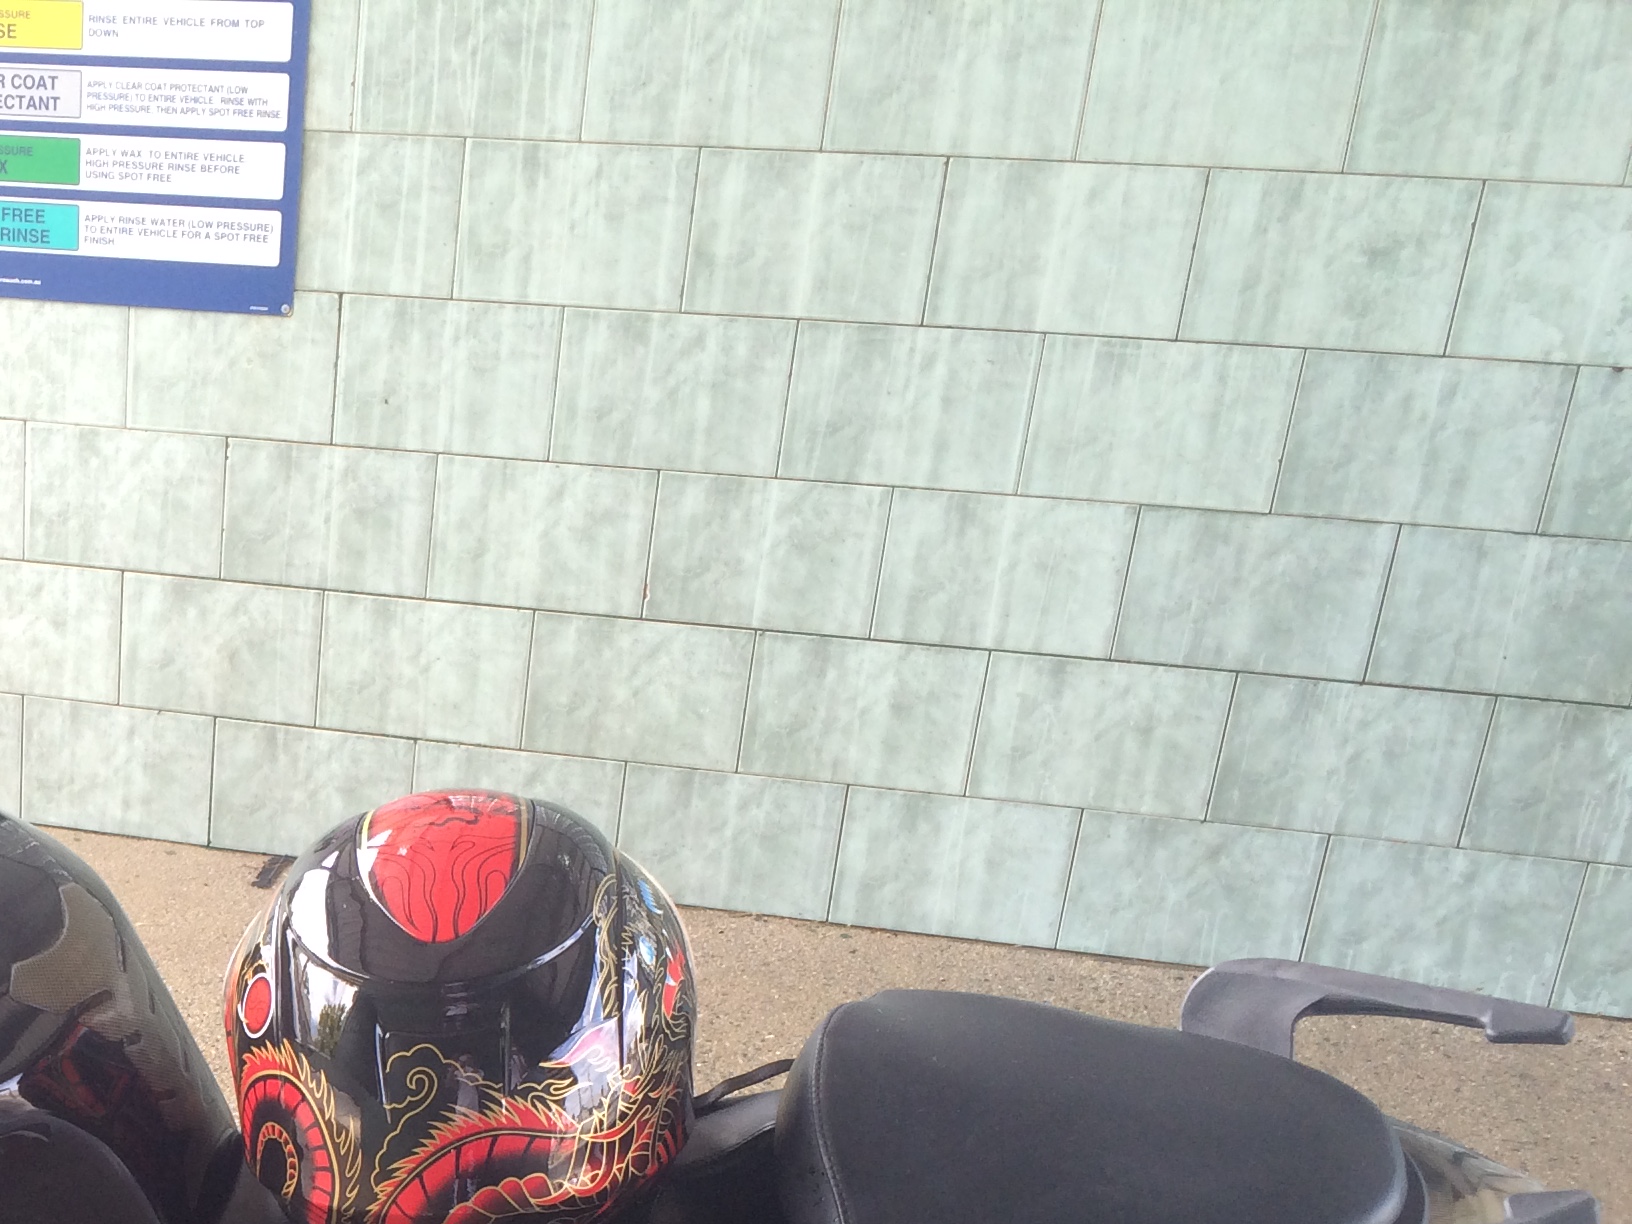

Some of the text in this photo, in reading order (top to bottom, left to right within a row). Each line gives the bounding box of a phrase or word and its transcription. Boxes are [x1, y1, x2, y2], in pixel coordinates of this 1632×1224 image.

[88, 14, 265, 29] RINSE ENTIRE VEHICLE FROM TOP
[88, 28, 119, 38] DOWN
[10, 73, 59, 91] COAT
[87, 80, 249, 95] APPLY CLEAR COAT PROTECTANT (LOW
[86, 92, 133, 102] PRESSURE)
[135, 93, 146, 102] TO
[148, 94, 178, 103] ENTIRE
[220, 96, 245, 106] RINSE
[247, 97, 269, 107] WITH
[86, 103, 106, 112] HIGH
[156, 105, 178, 115] THEN
[179, 106, 206, 116] APPLY
[208, 107, 230, 117] SPOT
[232, 108, 254, 118] FREE
[85, 147, 117, 157] APPLY
[120, 149, 142, 158] WAX
[149, 150, 162, 160] TO
[164, 151, 200, 161] ENTIRE
[85, 159, 241, 175] HIGH PRESSURE RINSE BEFORE
[85, 170, 172, 183] USING SPOT FREE
[1, 206, 46, 224] FREE
[84, 214, 274, 234] APPLY RINSE WATER (LOW PRESSURE)
[0, 226, 50, 244] RINSE
[84, 225, 269, 244] TO ENTIRE VEHICLE FOR A SPOT FREE
[84, 235, 115, 246] FINISH
